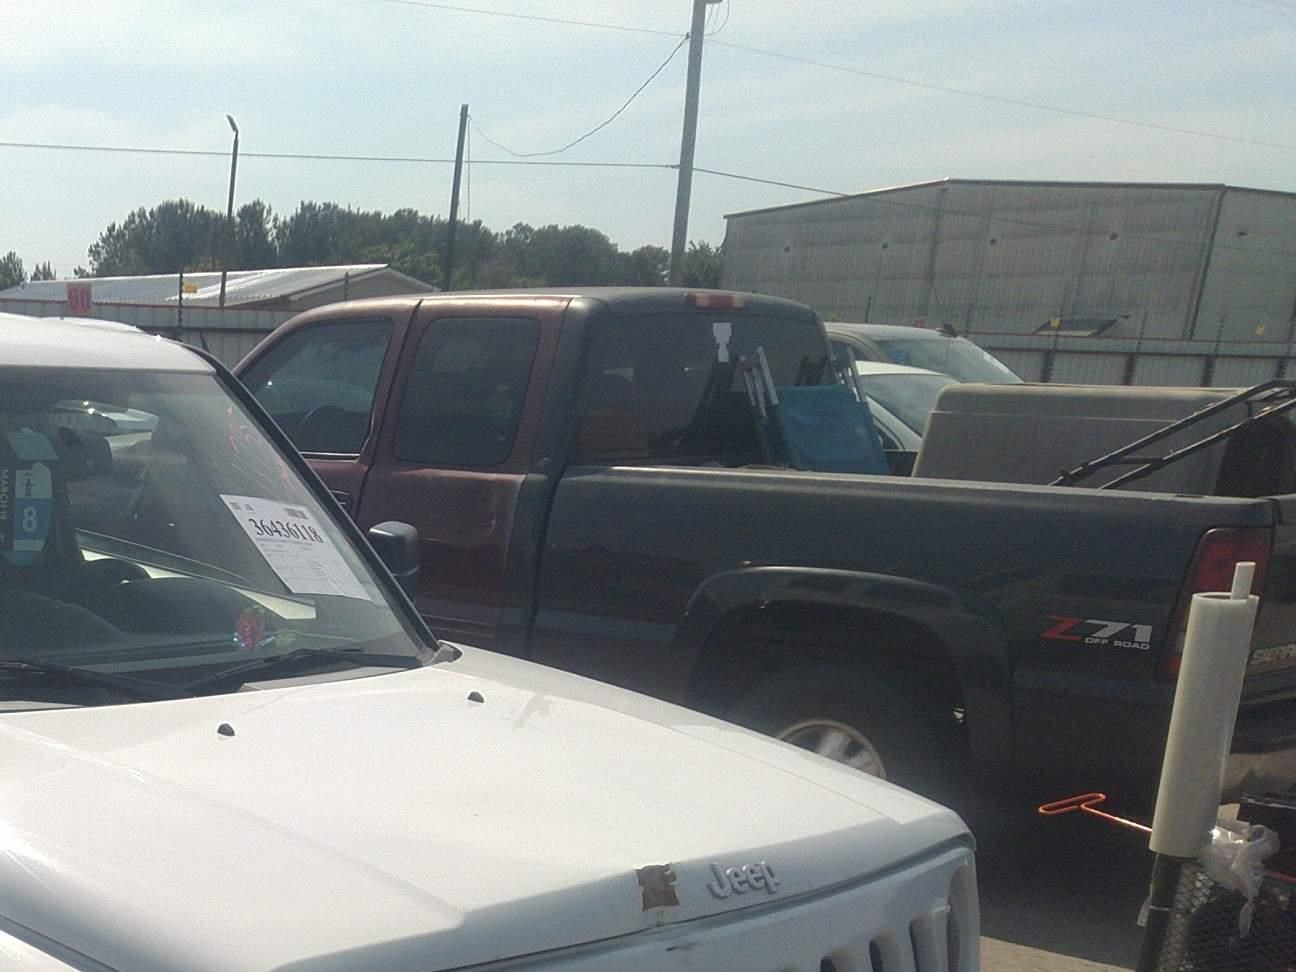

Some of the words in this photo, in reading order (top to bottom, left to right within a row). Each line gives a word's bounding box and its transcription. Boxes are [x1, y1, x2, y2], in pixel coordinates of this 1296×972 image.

[21, 505, 38, 532] 8
[247, 517, 325, 544] 36436118
[1039, 613, 1153, 643] Z71
[1084, 637, 1109, 646] OFF
[1114, 640, 1151, 651] ROAD
[706, 860, 782, 900] Jeep
